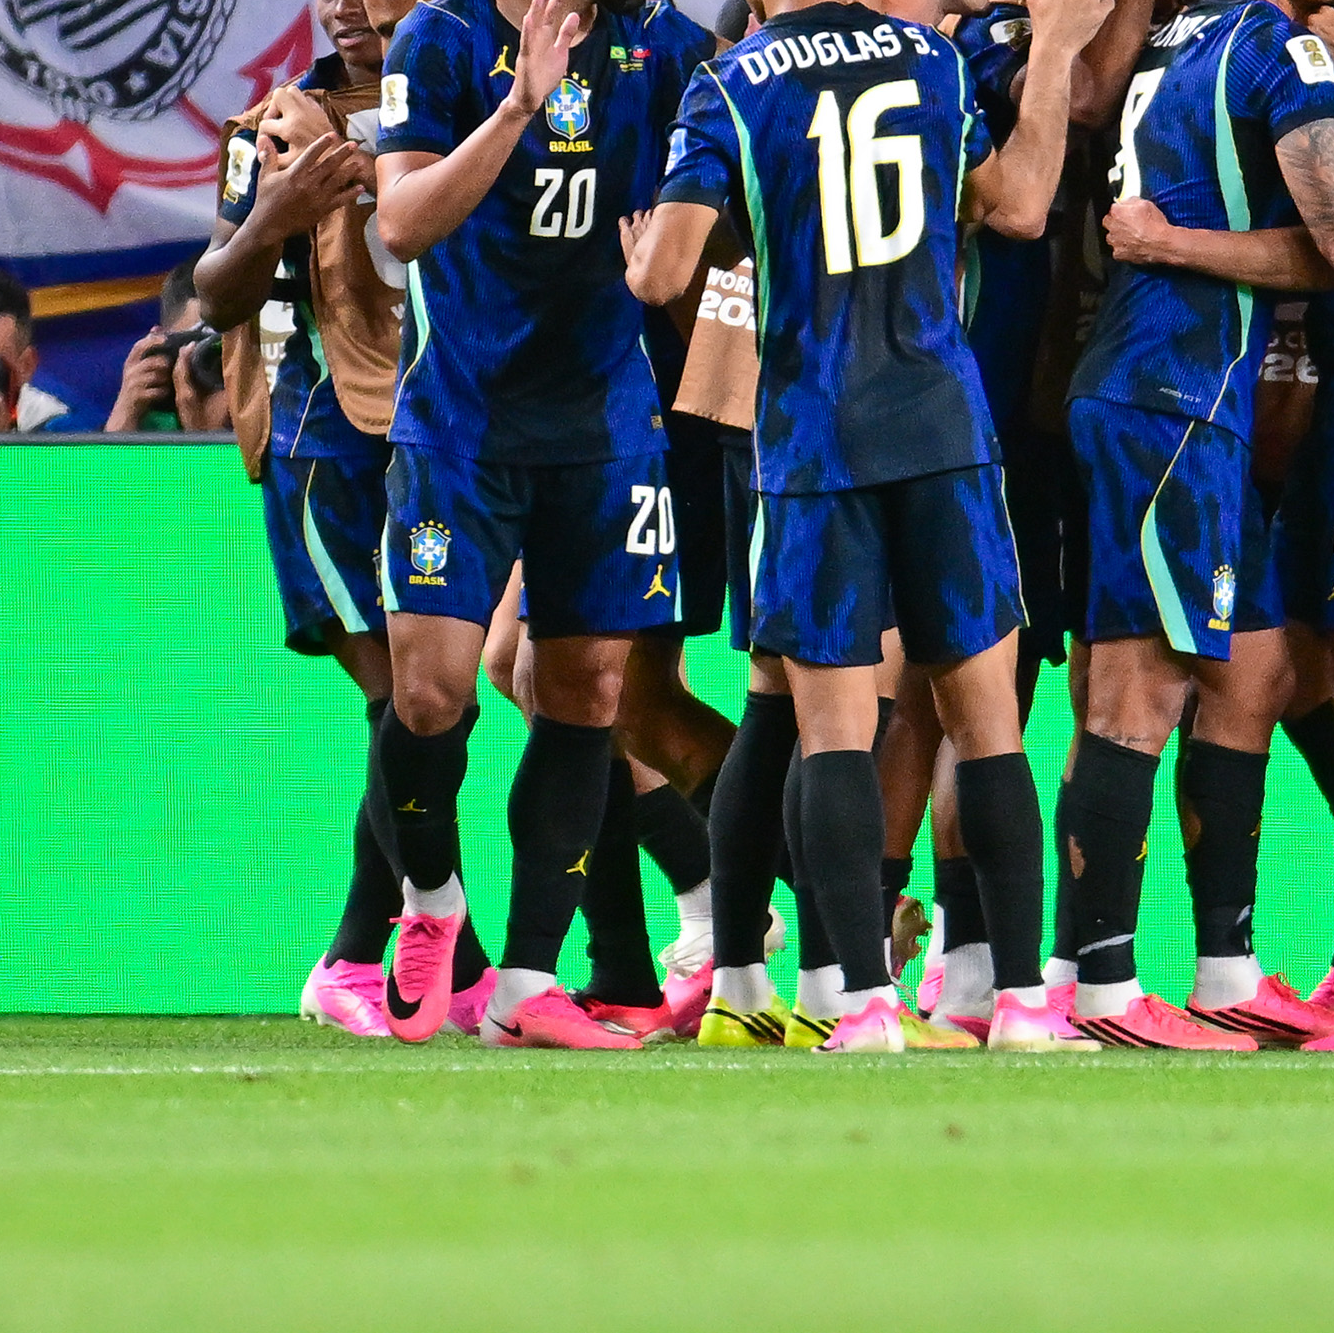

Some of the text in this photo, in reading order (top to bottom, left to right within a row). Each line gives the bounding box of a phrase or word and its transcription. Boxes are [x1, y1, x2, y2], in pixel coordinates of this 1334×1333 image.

[738, 24, 940, 86] DOUGLAS S.
[548, 140, 595, 153] BRASIL
[805, 79, 926, 275] 16
[528, 167, 597, 239] 20
[696, 289, 757, 332] 20
[625, 484, 676, 555] 20
[408, 574, 447, 587] BRASIL
